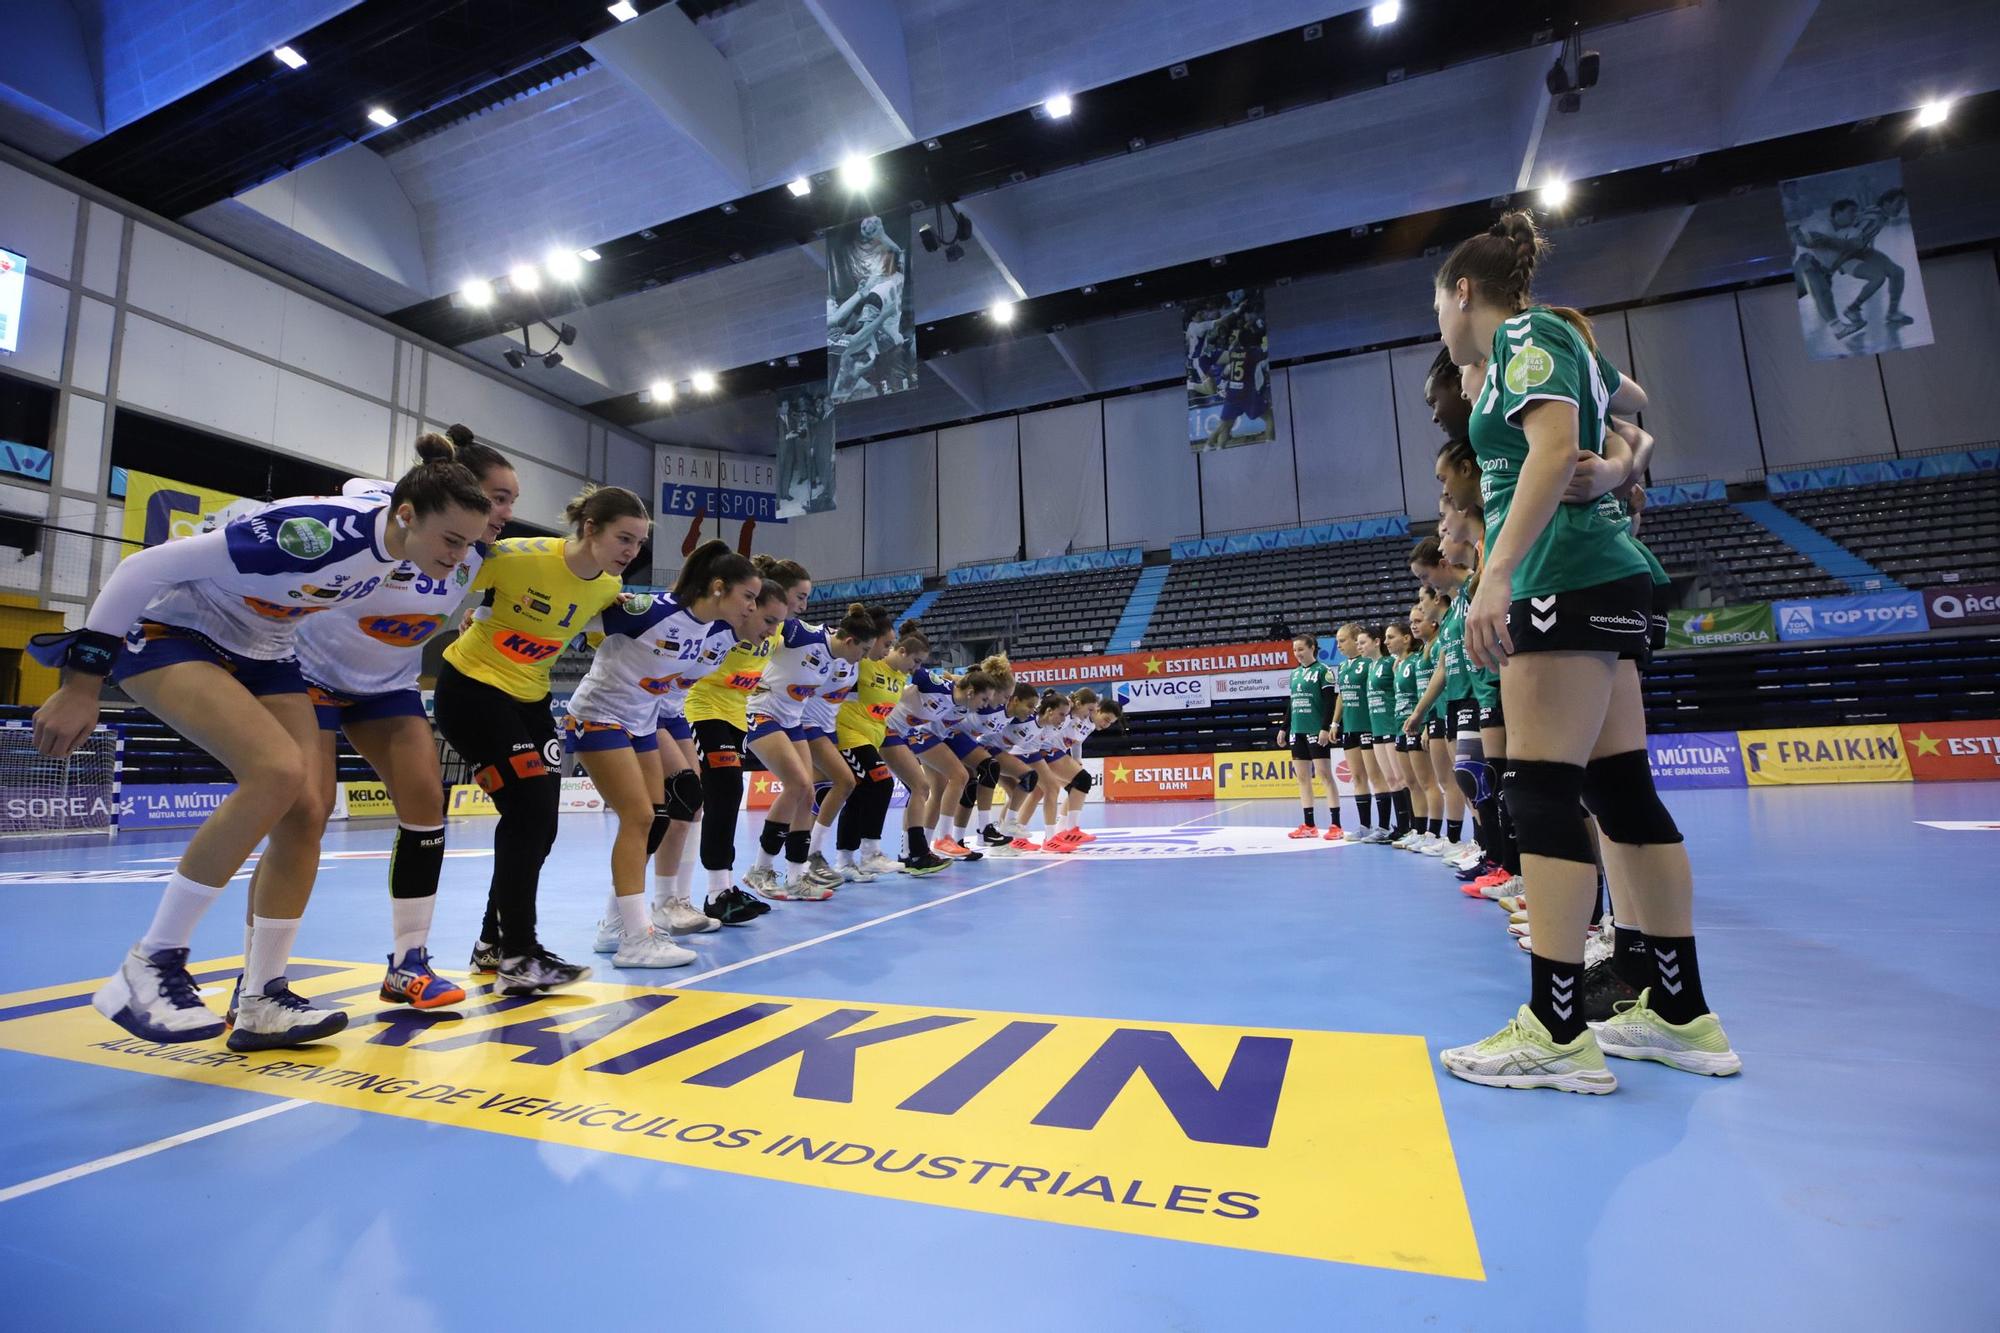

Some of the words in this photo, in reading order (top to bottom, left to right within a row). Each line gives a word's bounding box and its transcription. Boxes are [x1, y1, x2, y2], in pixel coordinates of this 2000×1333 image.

[664, 455, 773, 485] GRANOLLER
[670, 484, 697, 510] ÉS
[415, 573, 448, 596] 51
[558, 603, 578, 627] 1
[1820, 609, 1861, 625] TOP
[1863, 605, 1919, 622] TOYS
[502, 633, 559, 660] KH7
[1692, 629, 1770, 645] IBERDROLA
[678, 639, 704, 660] 23
[1166, 655, 1238, 673] ESTRELLA
[1240, 651, 1288, 668] DAMM
[1014, 667, 1078, 683] ESTRELLA
[1079, 663, 1124, 680] DAMM
[1228, 678, 1263, 687] Generalitat
[886, 676, 900, 693] 16
[1130, 679, 1202, 697] vivace
[1238, 684, 1270, 692] Catalunya
[1777, 736, 1899, 763] FRAIKIN
[1133, 766, 1213, 782] ESTRELLA
[1662, 767, 1673, 777] DE
[1674, 765, 1730, 777] GRANOLLERS
[1159, 781, 1188, 790] DAMM
[7, 797, 110, 819] SOREA
[246, 1060, 421, 1094] RENTING
[404, 1083, 487, 1105] DE
[477, 1092, 763, 1149] VEHÍCULOS
[761, 1133, 1262, 1221] INDUSTRIALES
